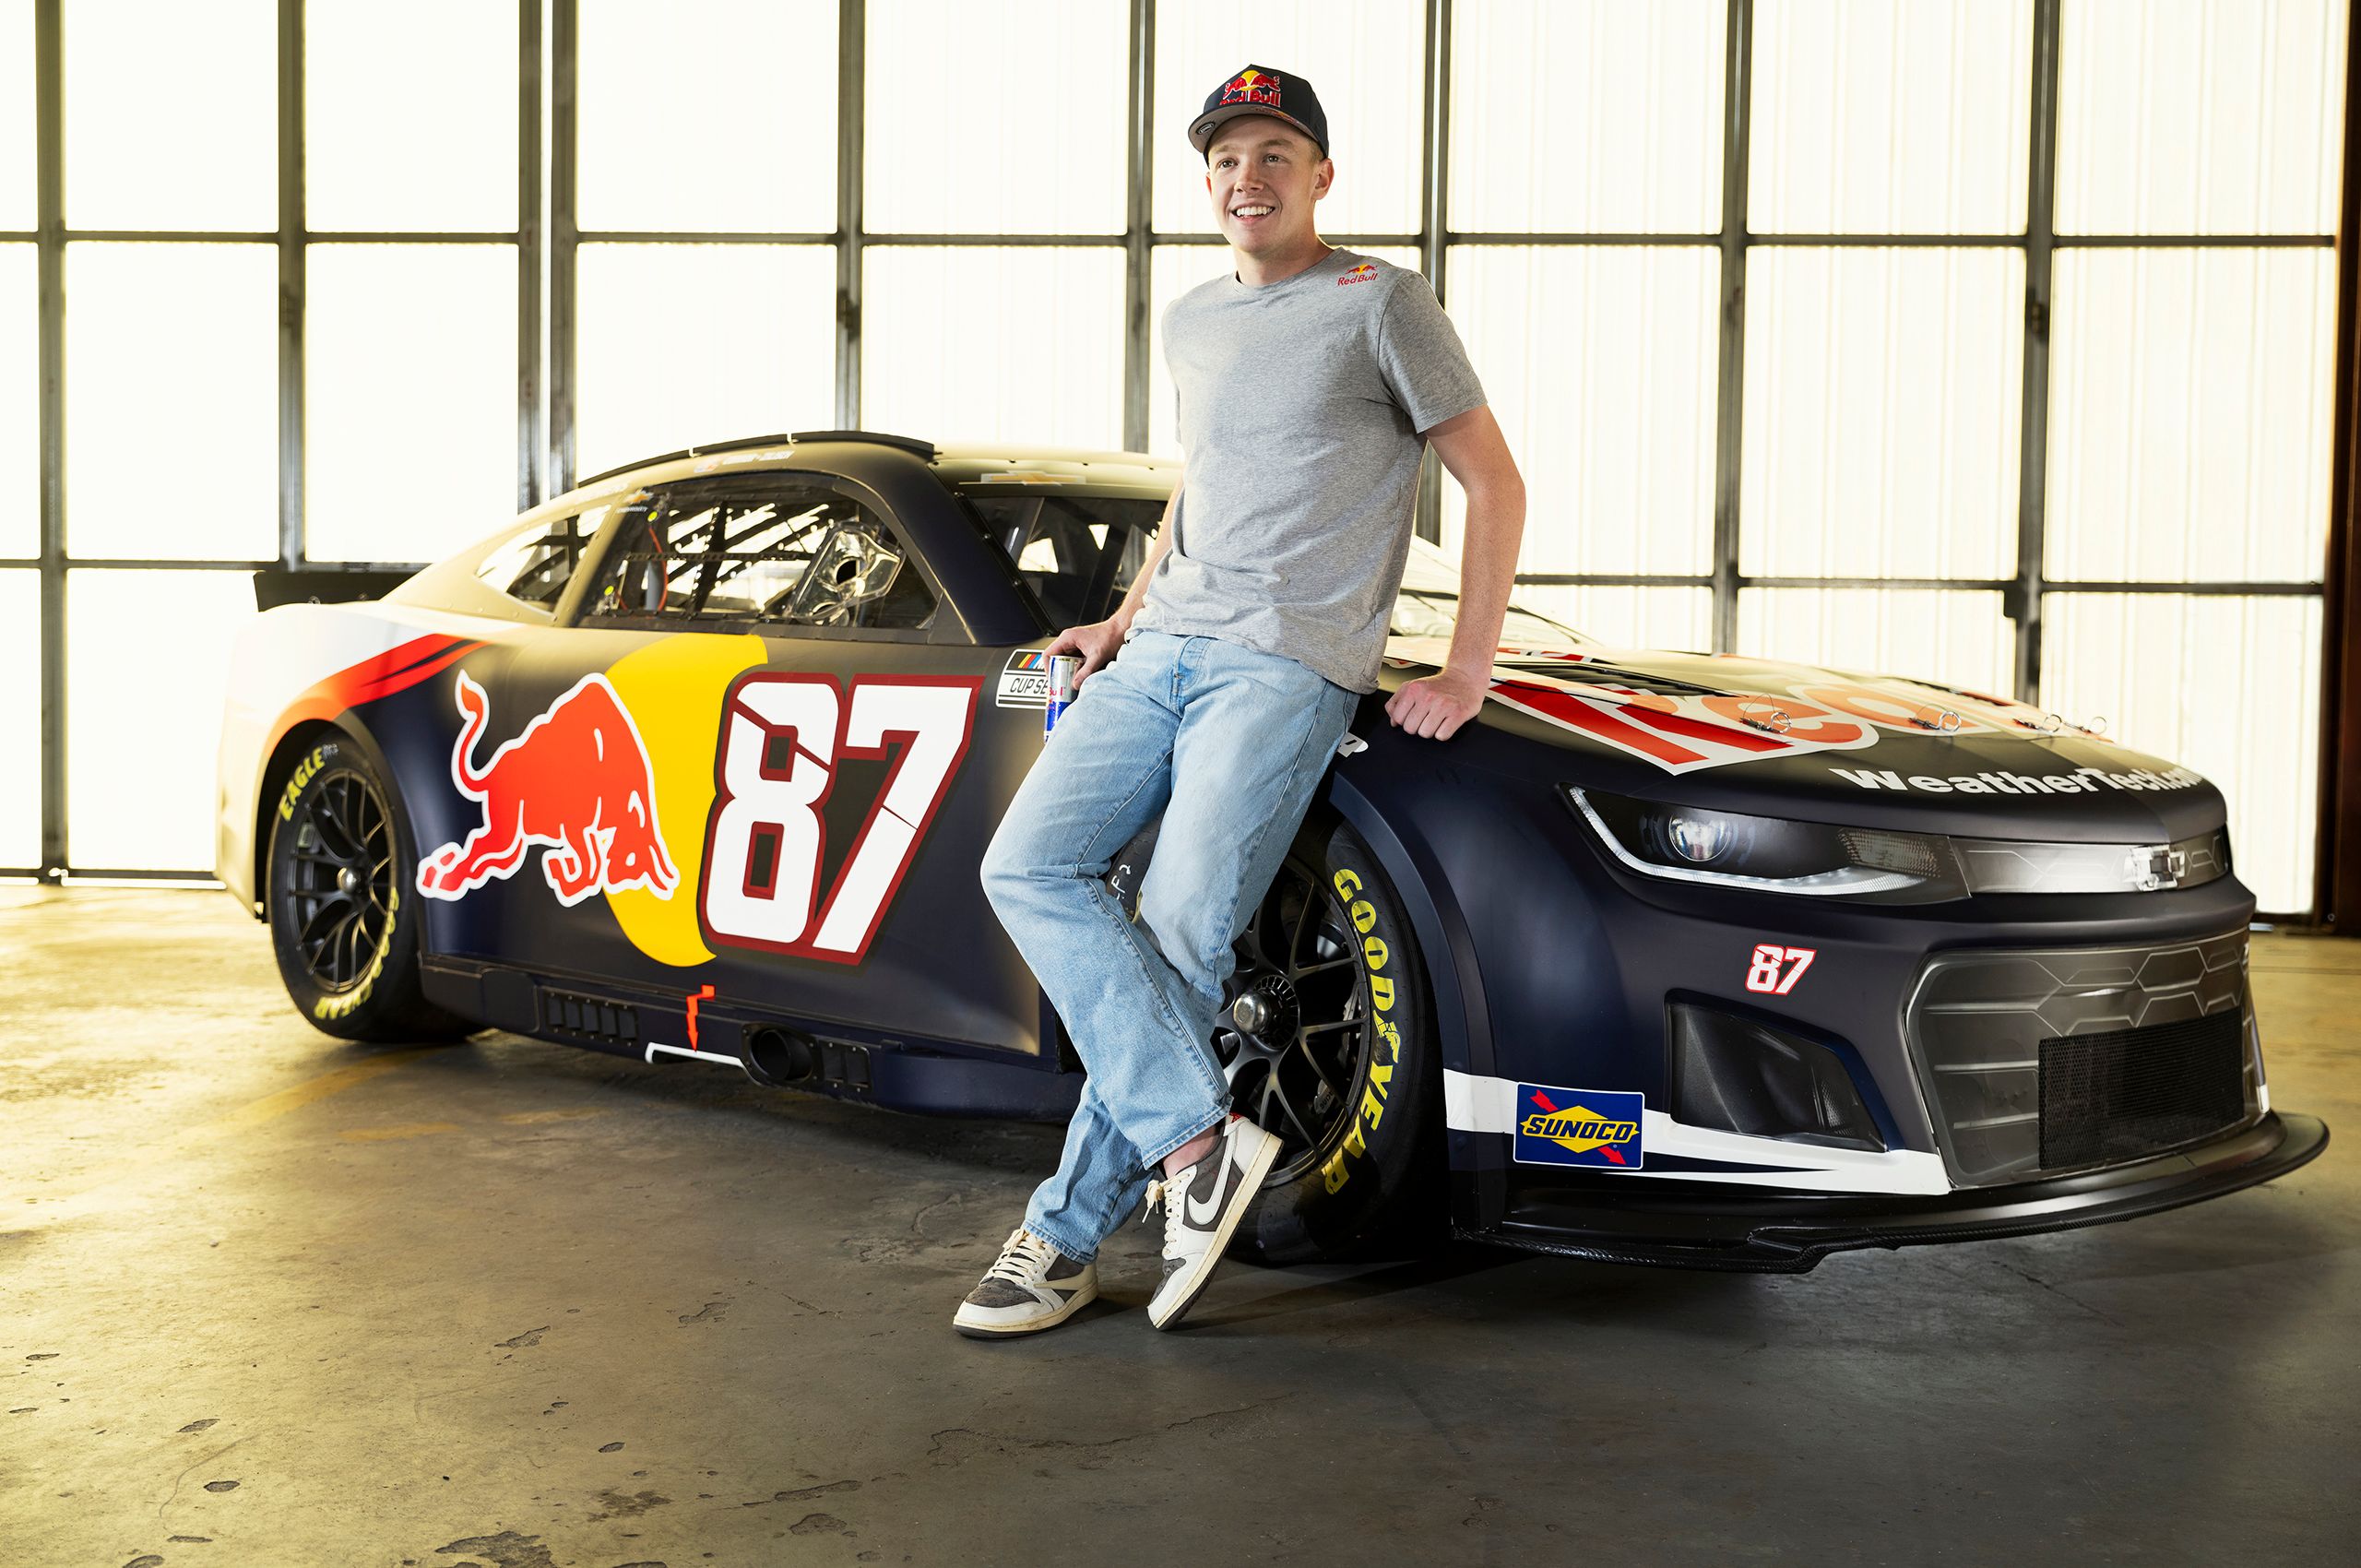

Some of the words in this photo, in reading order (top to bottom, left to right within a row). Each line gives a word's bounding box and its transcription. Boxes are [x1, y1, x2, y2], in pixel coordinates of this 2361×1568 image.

[1248, 89, 1281, 107] Bull
[1337, 274, 1358, 286] Red
[1358, 273, 1379, 282] Bull
[1010, 677, 1035, 694] CUP
[279, 747, 326, 822] EAGLE
[702, 672, 984, 965] 87
[1745, 943, 1817, 996] 87
[1321, 868, 1398, 1195] GOODYEAR
[1525, 1116, 1634, 1142] SUNOCO
